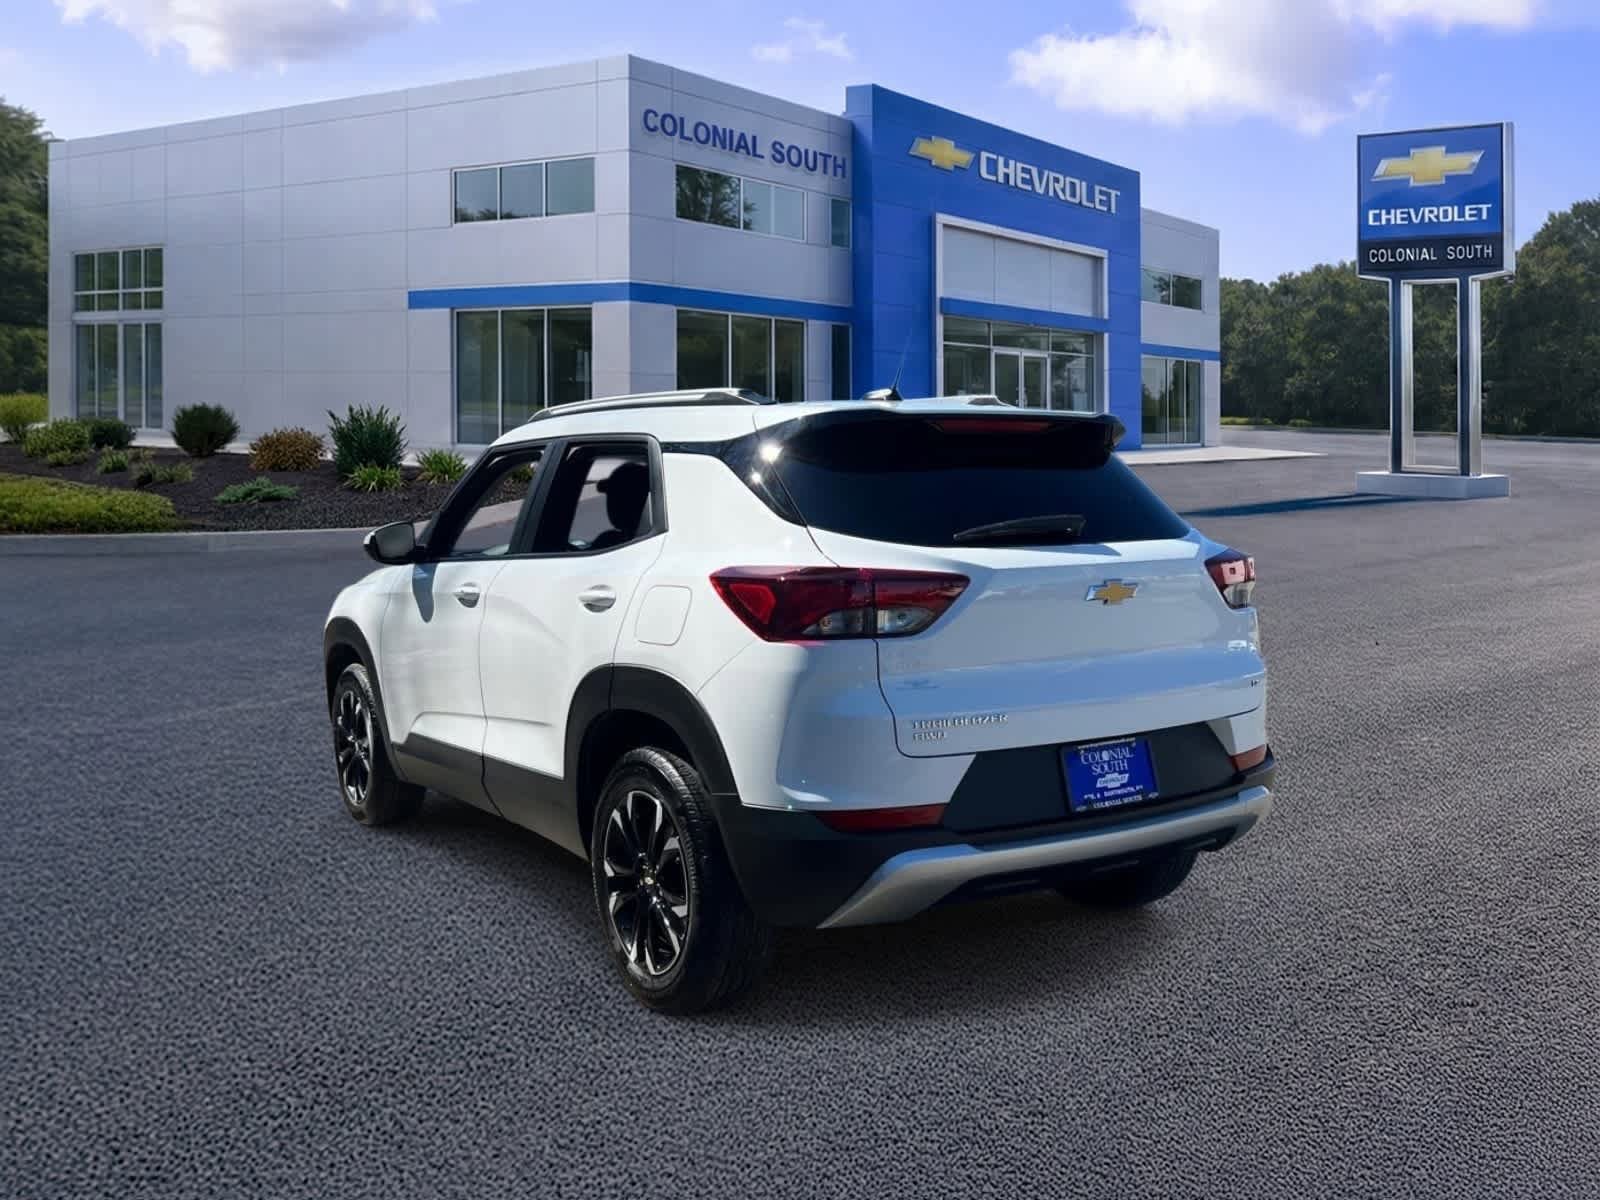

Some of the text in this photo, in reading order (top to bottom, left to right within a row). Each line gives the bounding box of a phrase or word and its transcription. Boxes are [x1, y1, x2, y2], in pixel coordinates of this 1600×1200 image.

[642, 107, 847, 179] COLONIAL SOUTH
[978, 150, 1121, 215] CHEVROLET
[1367, 203, 1492, 226] CHEVROLET
[1368, 244, 1493, 263] COLONIAL SOUTH
[1081, 747, 1134, 765] COLONIAL
[1091, 760, 1128, 776] SOUTH
